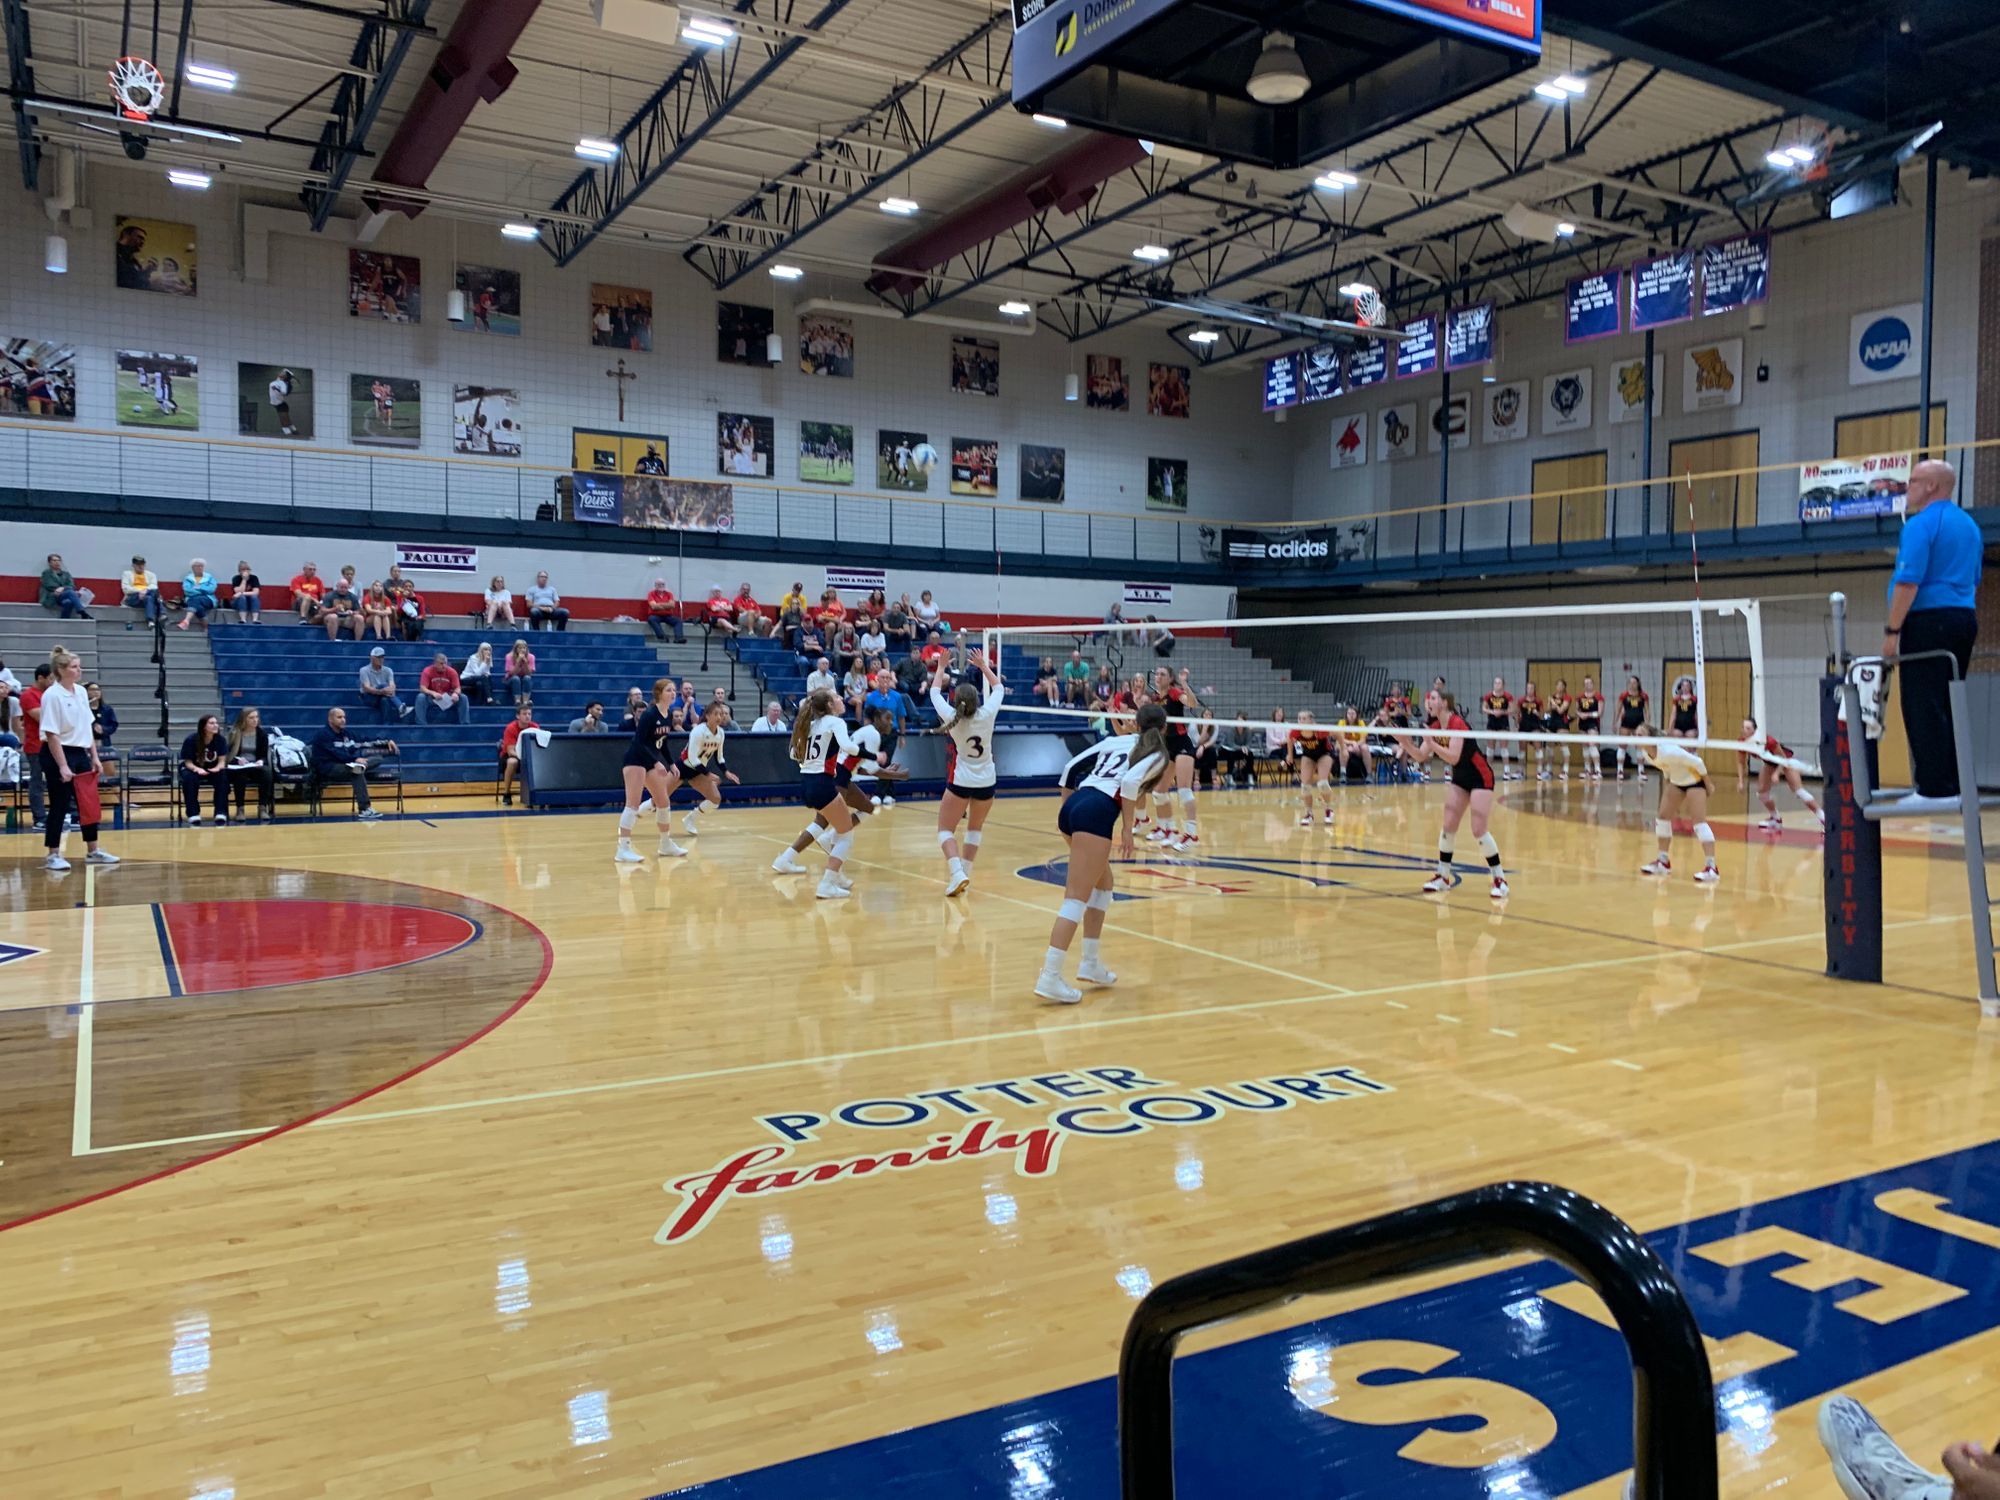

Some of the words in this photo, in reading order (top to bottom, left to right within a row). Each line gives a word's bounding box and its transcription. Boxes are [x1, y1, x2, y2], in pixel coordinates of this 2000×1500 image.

[1864, 339, 1910, 362] NCAA
[1804, 466, 1819, 479] NO
[1880, 455, 1908, 471] DAYS
[578, 491, 616, 509] YOURS
[592, 489, 608, 497] MAKE
[404, 552, 470, 565] FACULTY
[1268, 539, 1328, 558] adidas
[805, 734, 821, 760] 15
[965, 735, 984, 759] 3
[1094, 751, 1128, 778] 12
[760, 1066, 1165, 1142] POTTER
[1056, 1065, 1390, 1136] COURT
[656, 1119, 1064, 1244] family
